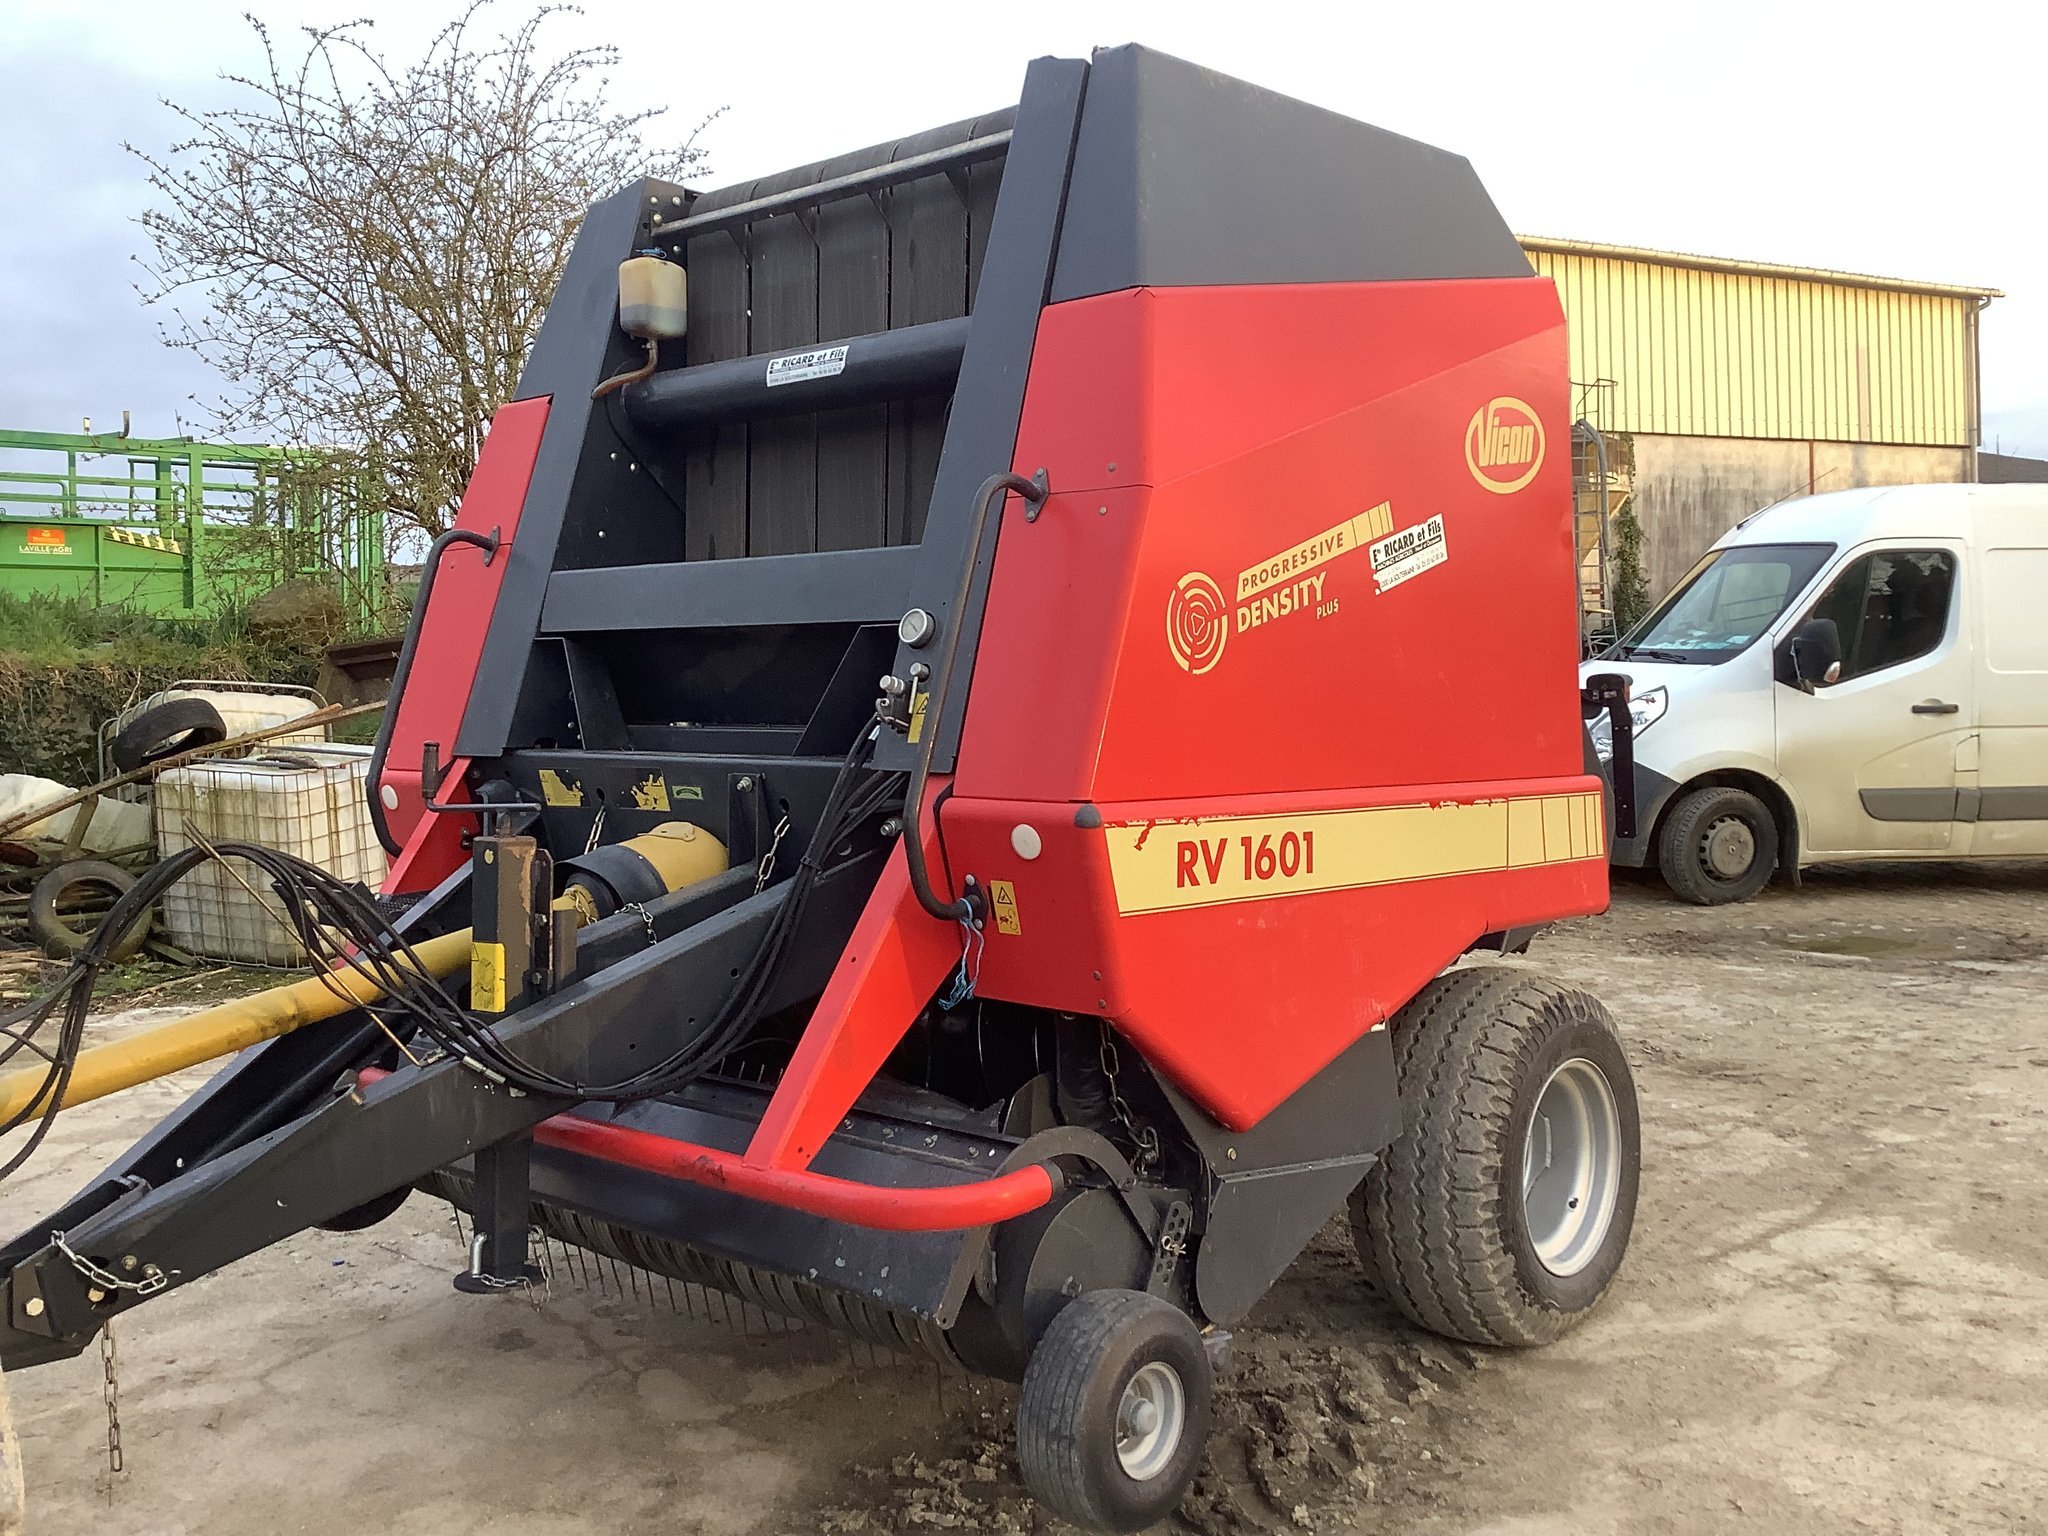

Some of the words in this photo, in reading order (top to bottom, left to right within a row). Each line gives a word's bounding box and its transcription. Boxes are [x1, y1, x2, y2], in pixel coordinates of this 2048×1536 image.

[781, 354, 815, 368] RICARD
[817, 352, 827, 361] et
[829, 349, 845, 359] Fils
[1473, 402, 1536, 467] Vicon
[1242, 531, 1344, 593] PROGRESSIVE
[1384, 532, 1415, 558] RICARD
[1417, 527, 1426, 542] et
[1427, 519, 1442, 537] Fils
[1236, 571, 1327, 634] DENSITY
[1316, 598, 1340, 620] PLUS
[1177, 837, 1228, 888] RV
[1241, 831, 1313, 881] 1601
